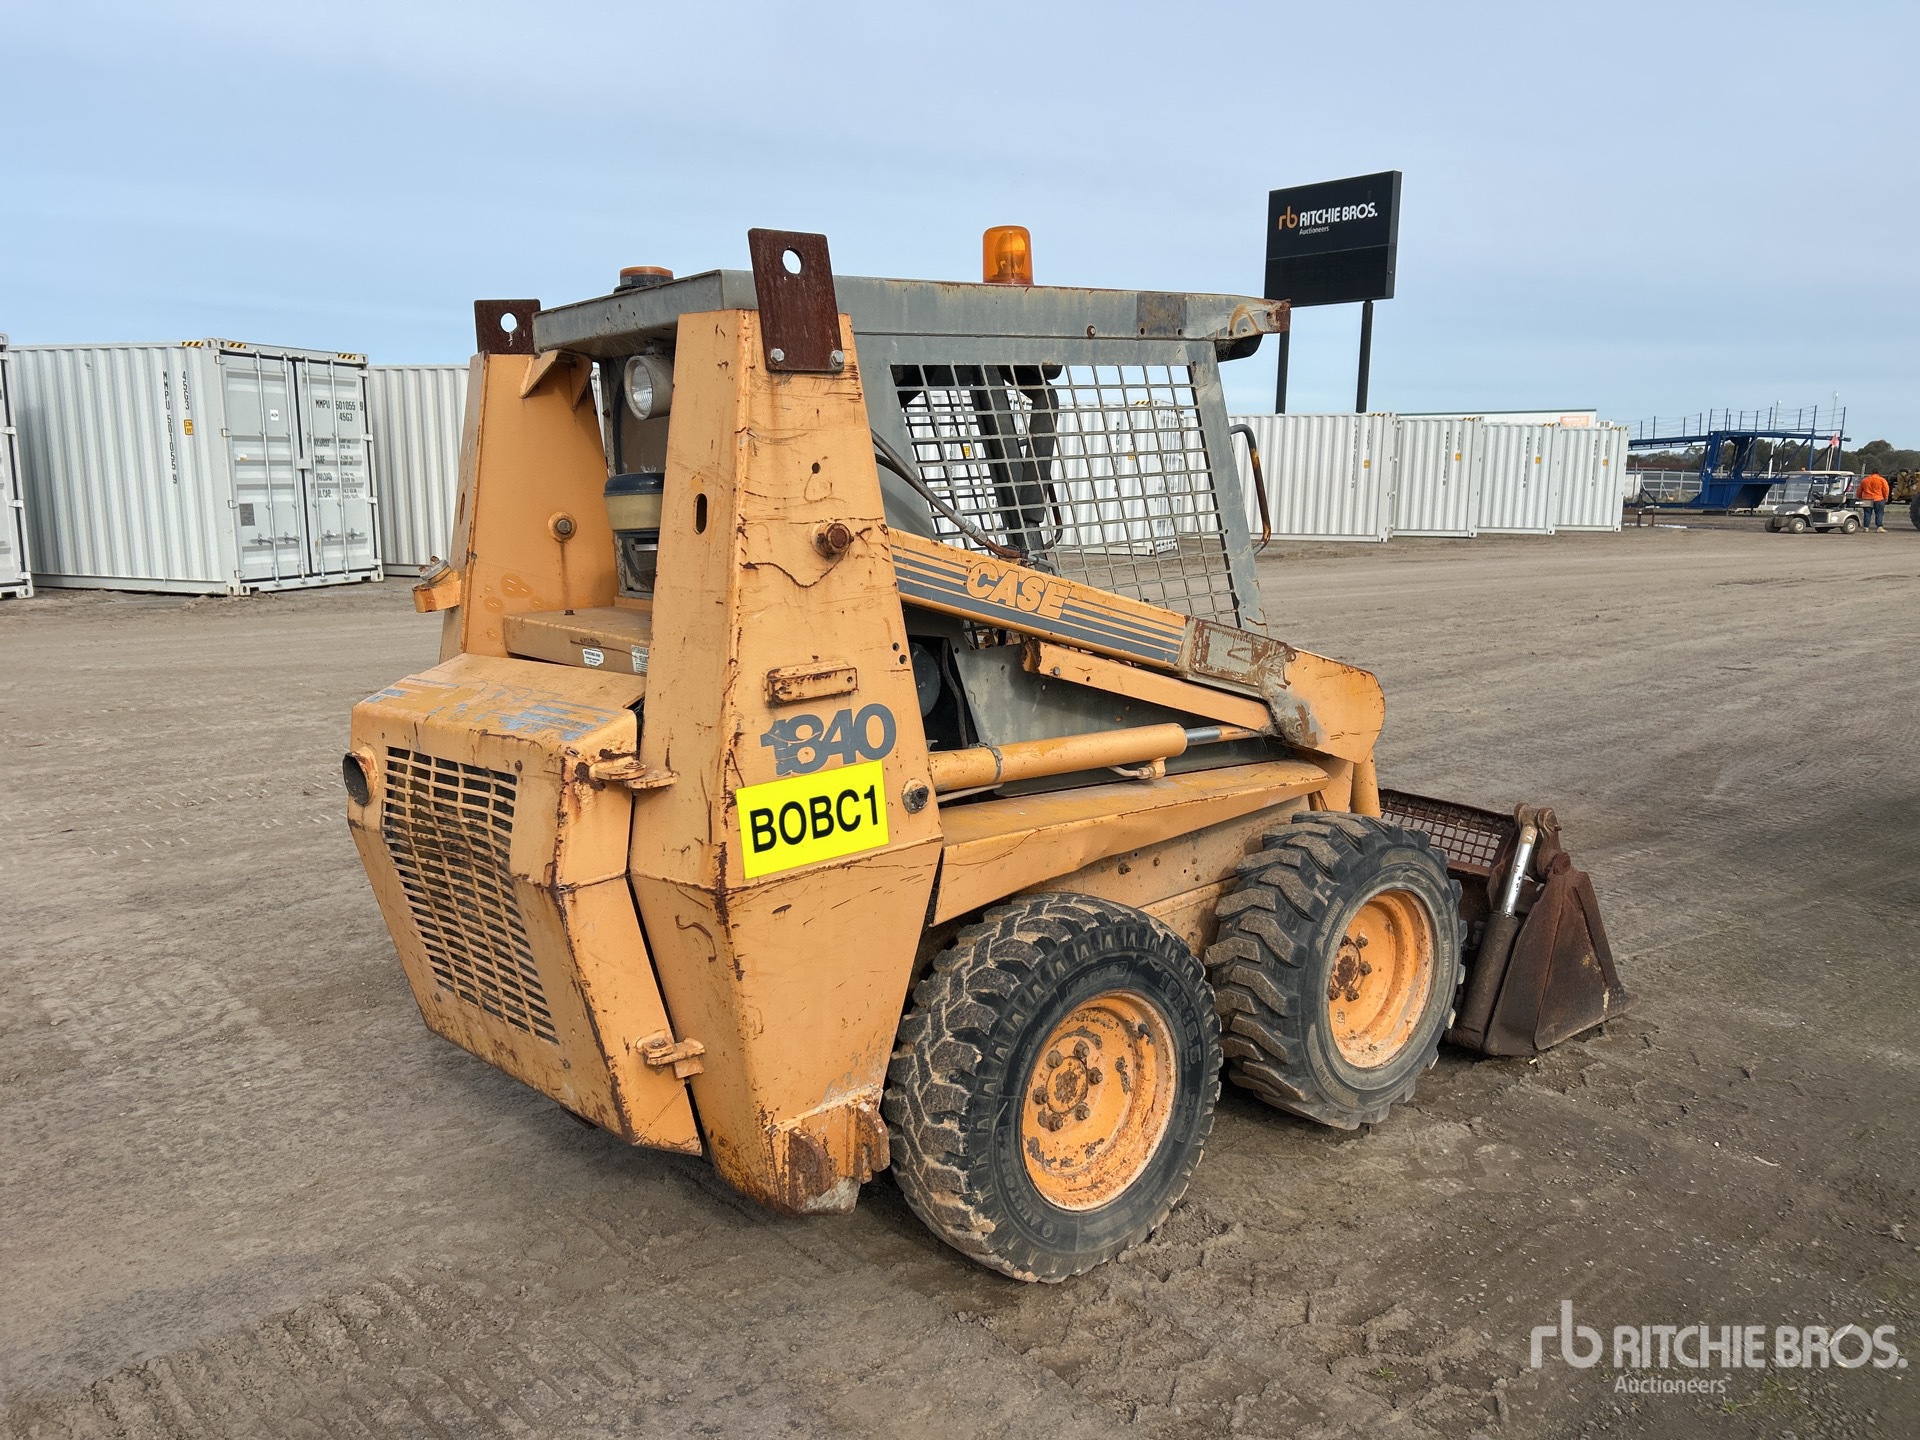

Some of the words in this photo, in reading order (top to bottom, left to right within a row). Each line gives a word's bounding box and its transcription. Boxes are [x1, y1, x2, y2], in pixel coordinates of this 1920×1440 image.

[1278, 206, 1298, 230] rb
[1300, 207, 1341, 227] RITCHIE
[1342, 202, 1378, 221] BROS.
[1299, 226, 1330, 236] Auctioneers
[162, 371, 171, 410] MMPU
[315, 399, 331, 409] MMPU
[339, 412, 353, 422] 45G3
[966, 562, 1073, 619] CASE
[760, 703, 897, 777] 1840
[749, 784, 879, 854] BOBC1
